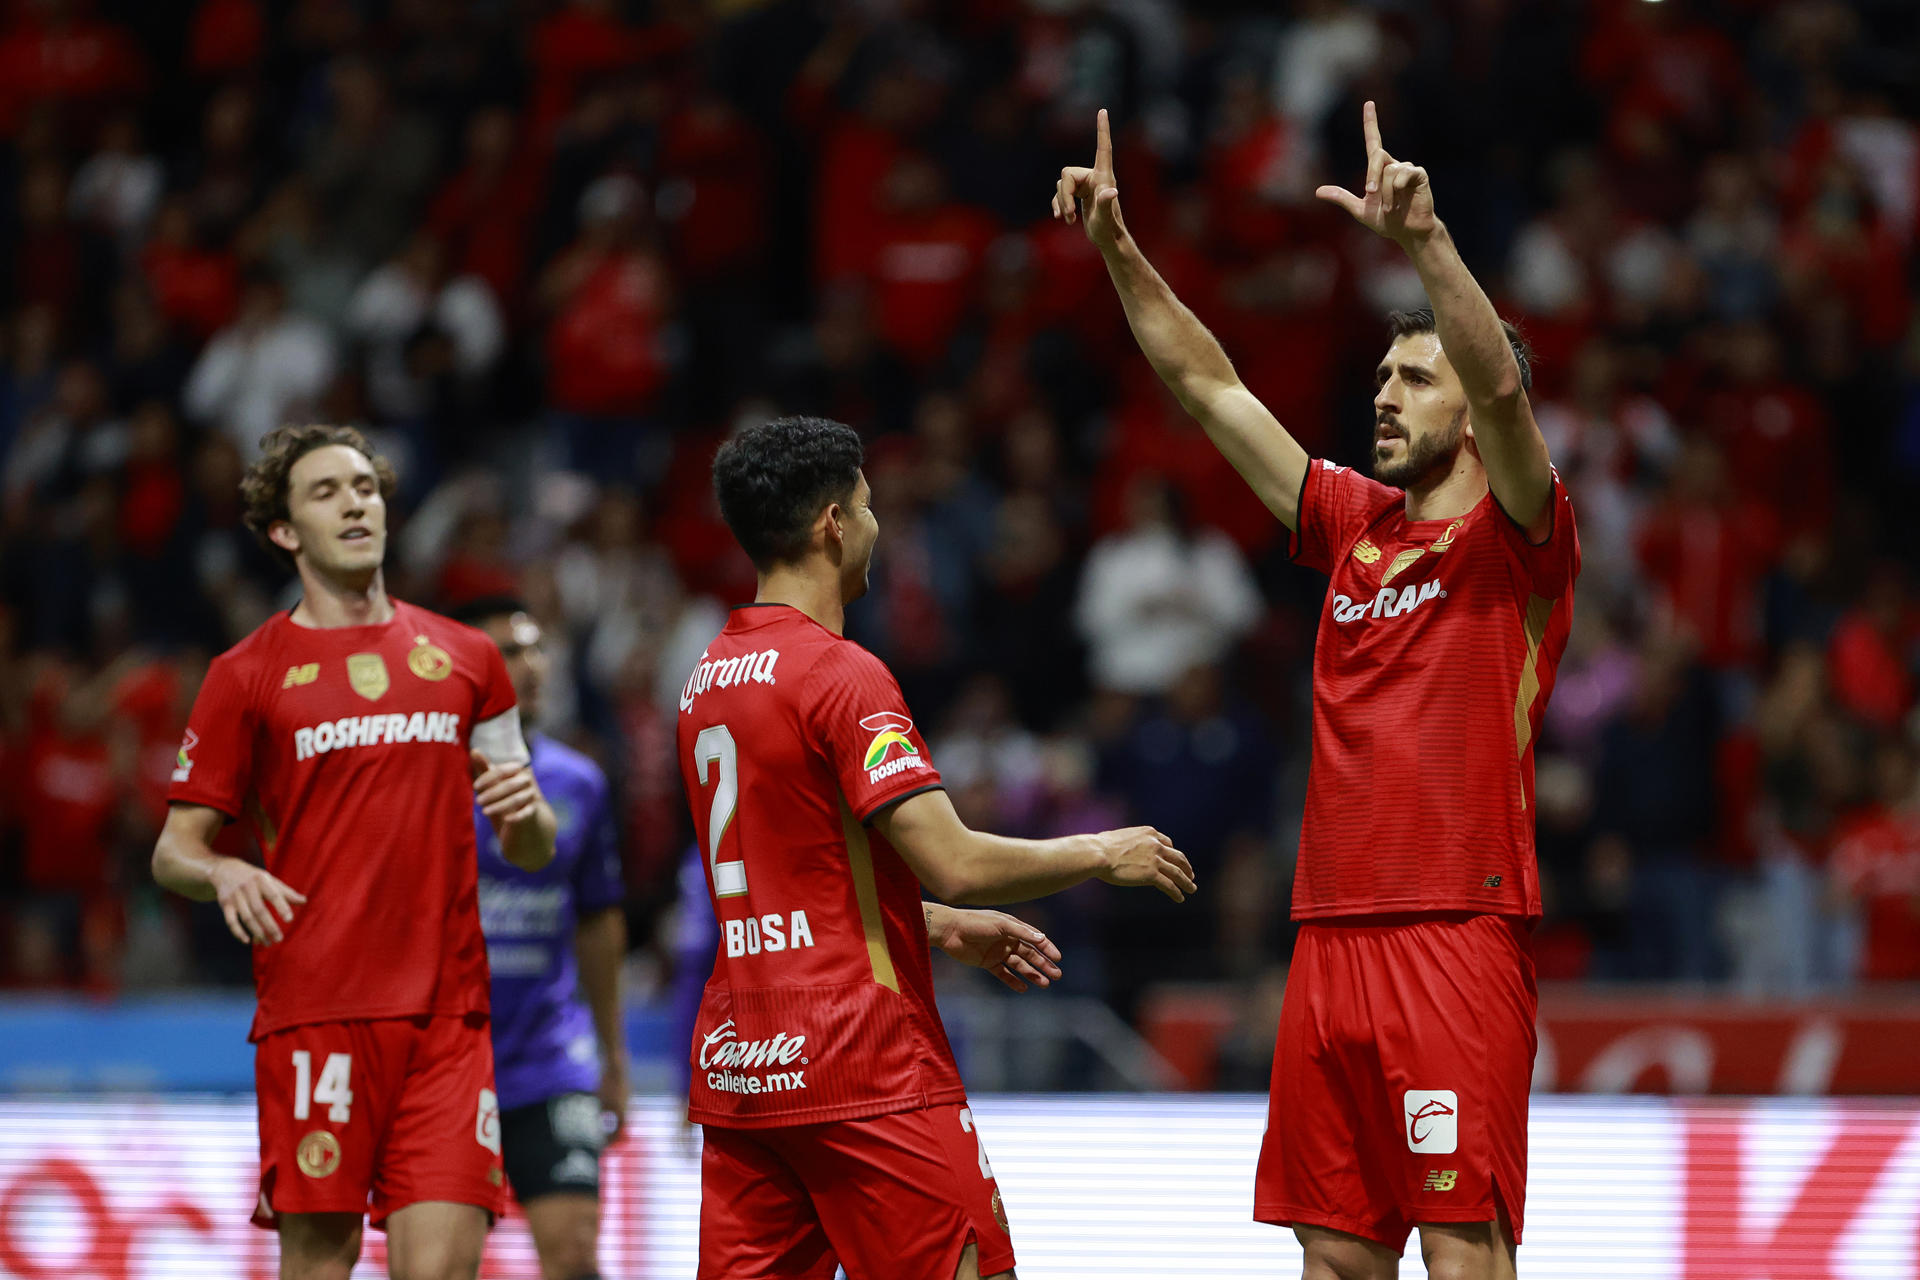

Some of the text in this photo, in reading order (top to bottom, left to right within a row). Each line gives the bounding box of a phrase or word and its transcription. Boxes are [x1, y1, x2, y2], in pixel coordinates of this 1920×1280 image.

[295, 711, 459, 761] ROSHFRANS
[694, 724, 749, 898] 2
[721, 910, 815, 958] BOSA
[292, 1050, 353, 1123] 14
[707, 1069, 807, 1094] caliete.mx
